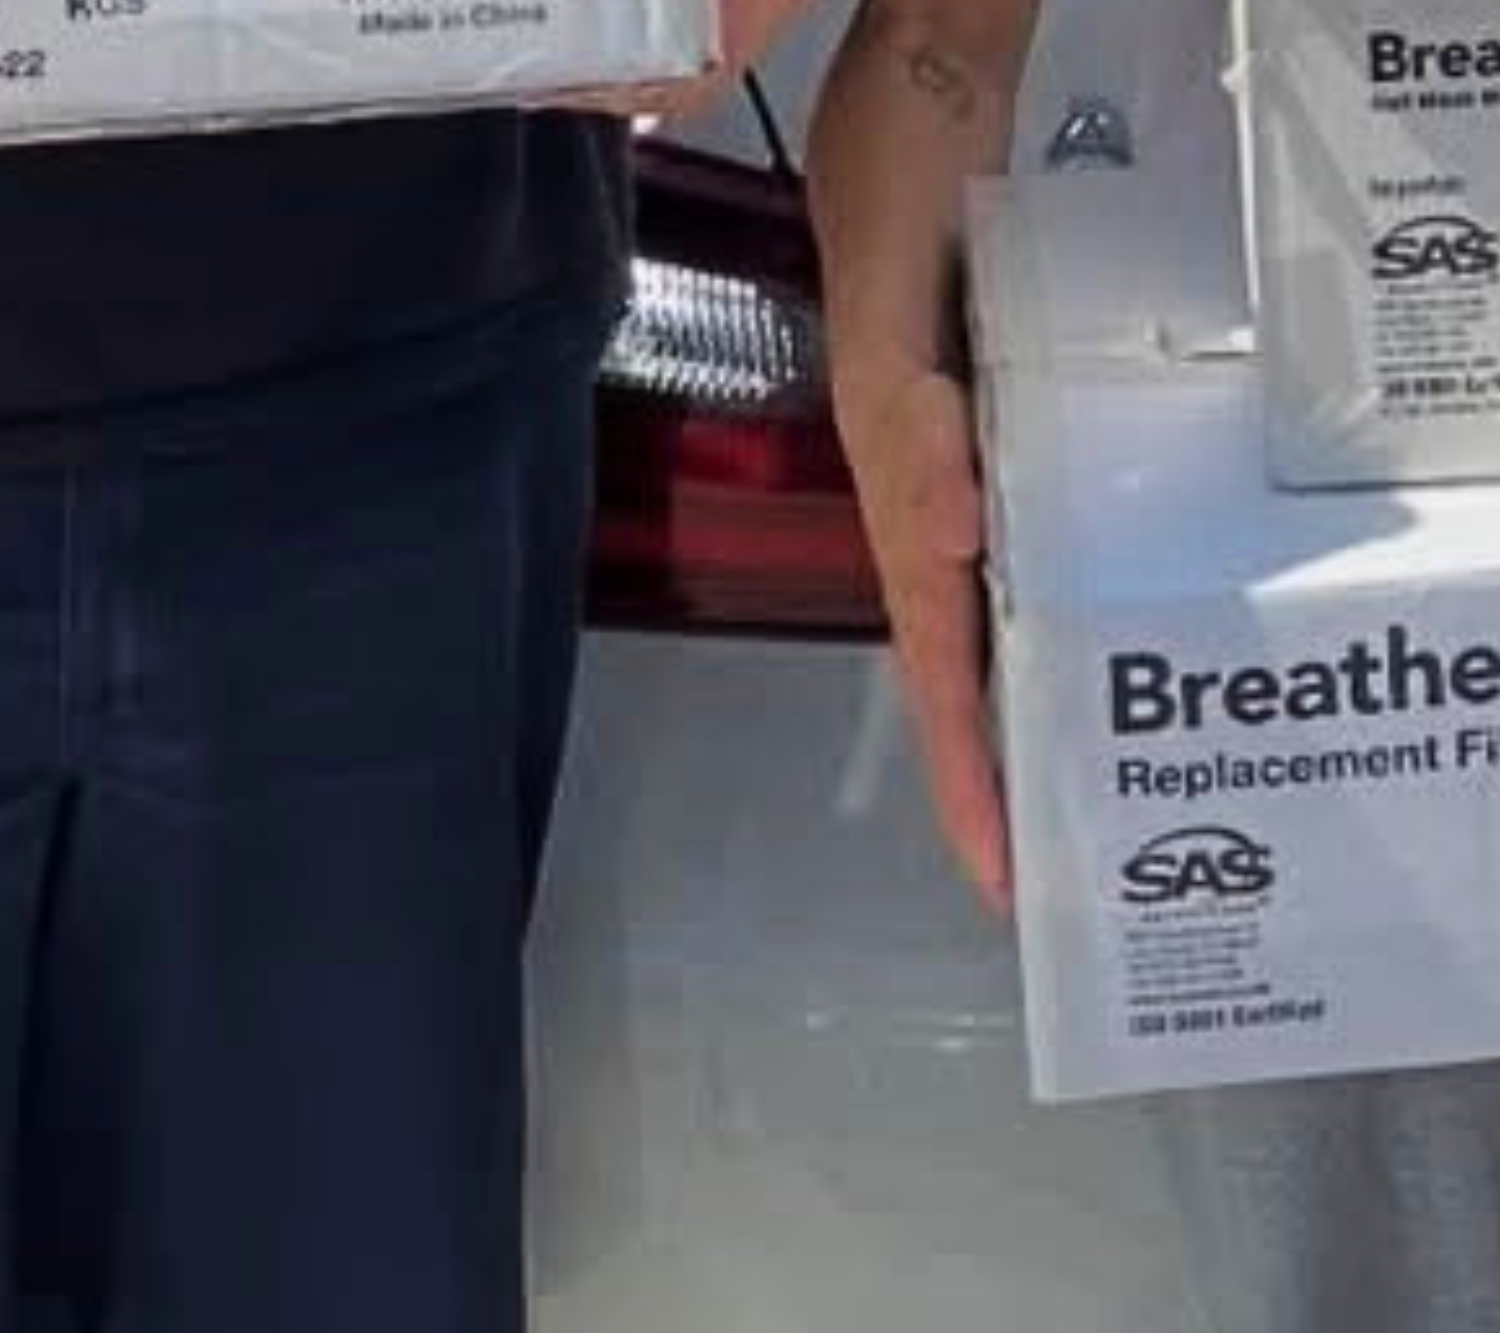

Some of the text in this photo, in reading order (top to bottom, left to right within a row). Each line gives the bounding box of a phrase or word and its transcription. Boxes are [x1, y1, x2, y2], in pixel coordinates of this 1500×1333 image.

[1371, 222, 1500, 280] SAS
[1116, 737, 1441, 799] Replacement
[1121, 831, 1275, 904] SAS
